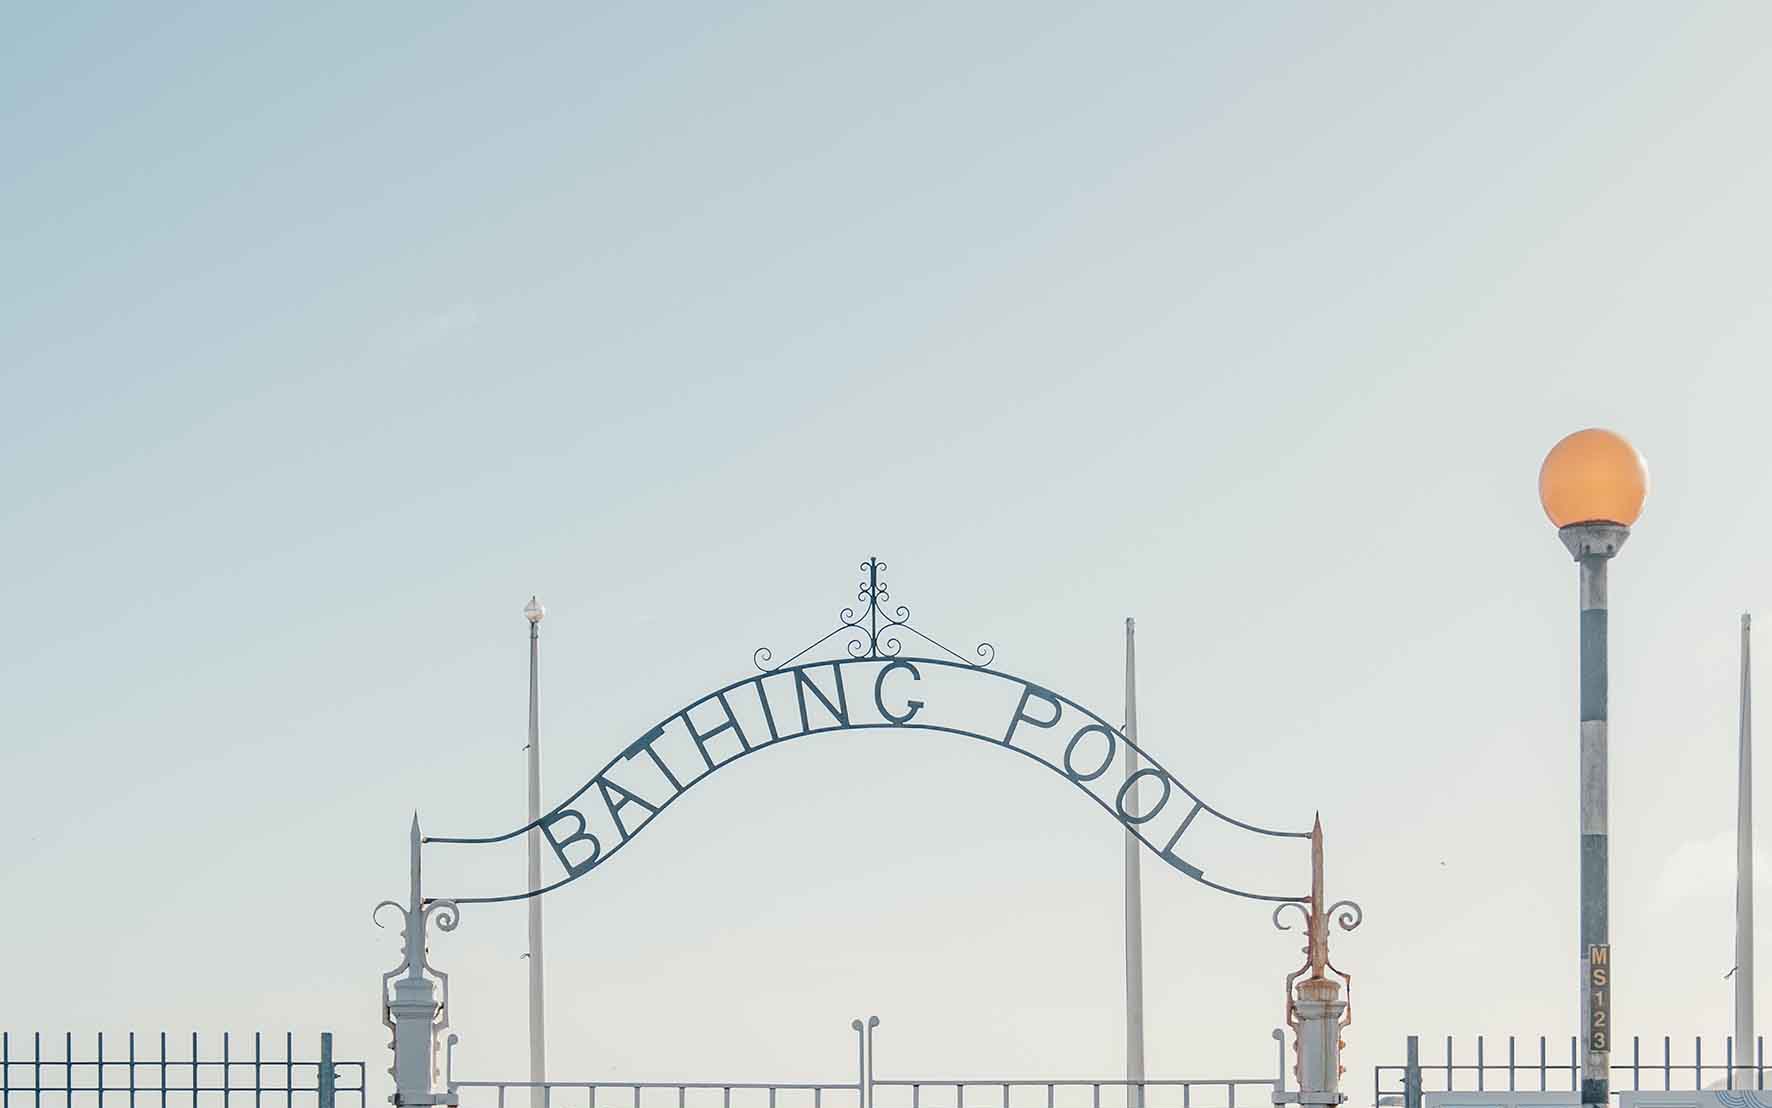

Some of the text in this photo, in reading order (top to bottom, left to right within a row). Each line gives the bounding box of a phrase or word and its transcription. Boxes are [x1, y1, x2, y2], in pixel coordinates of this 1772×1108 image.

[540, 660, 1204, 880] BATHING POOL
[1591, 948, 1607, 1048] MS123
